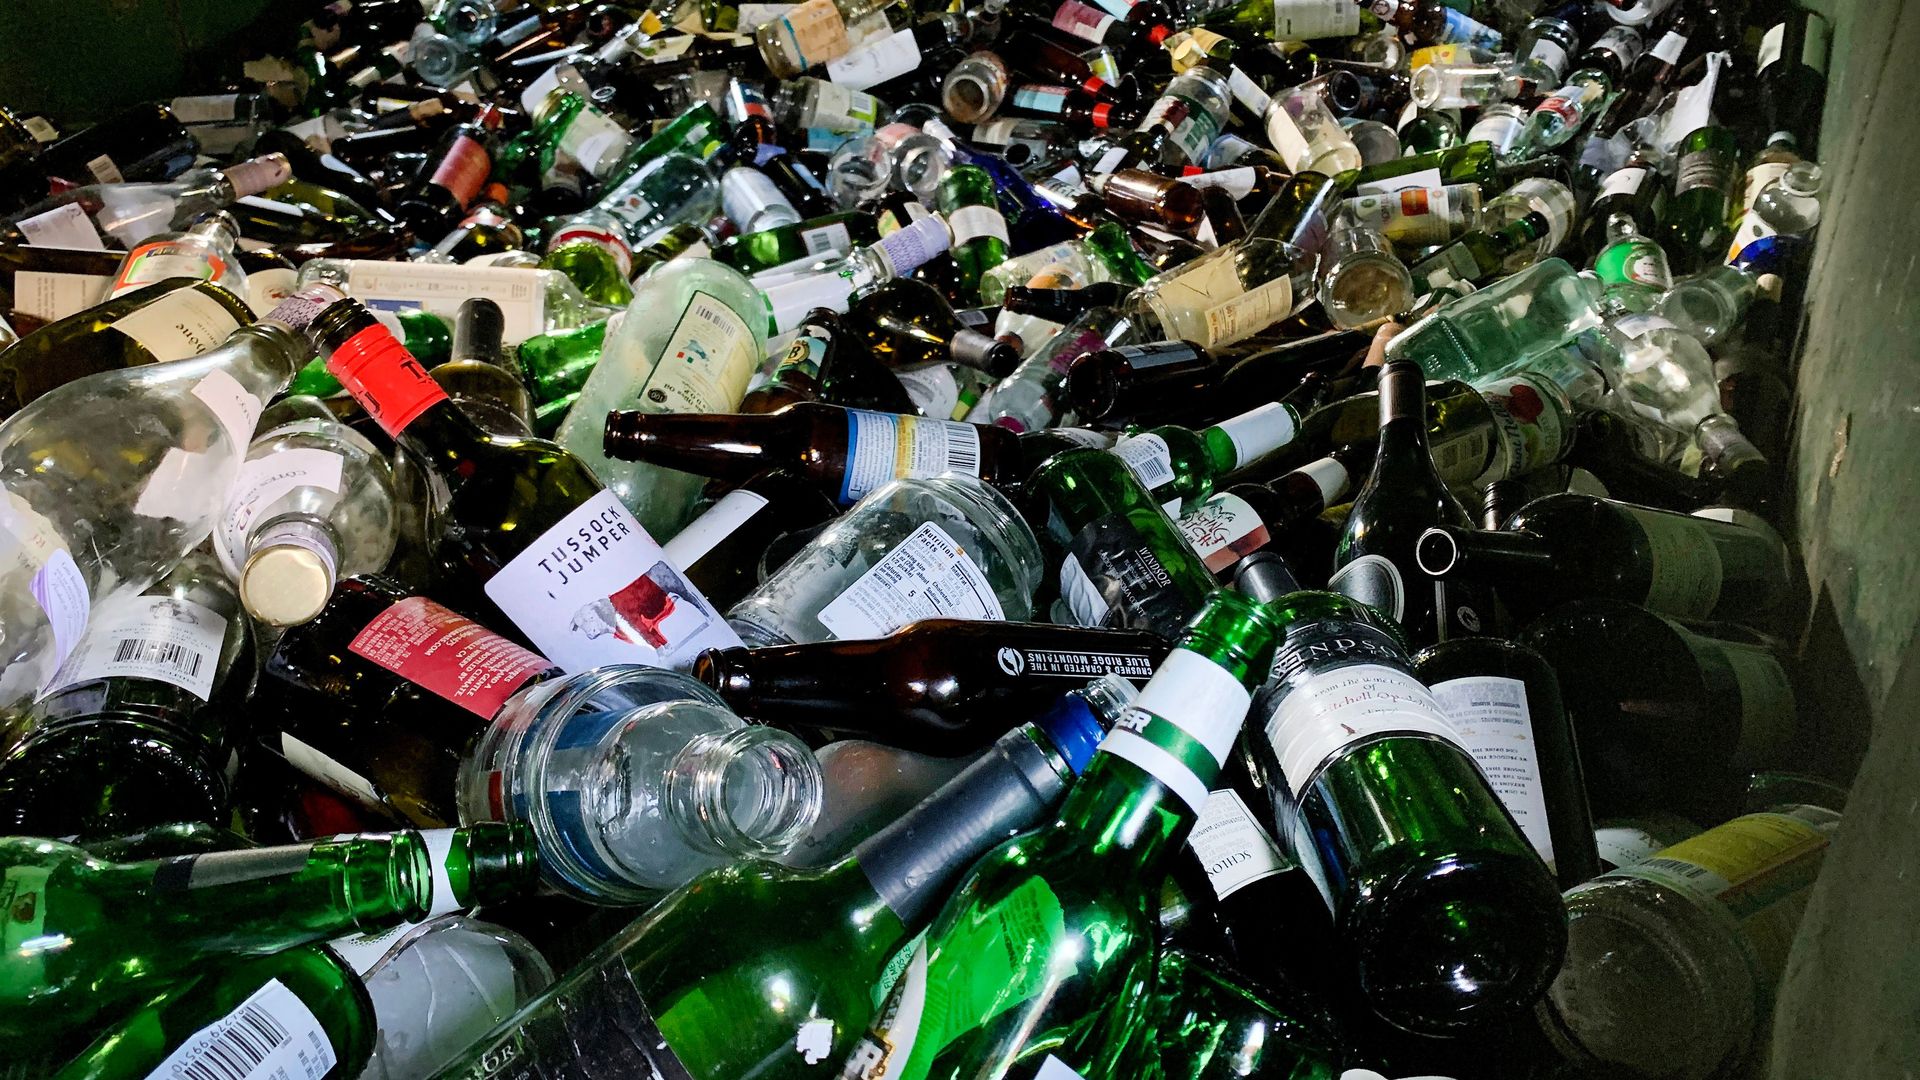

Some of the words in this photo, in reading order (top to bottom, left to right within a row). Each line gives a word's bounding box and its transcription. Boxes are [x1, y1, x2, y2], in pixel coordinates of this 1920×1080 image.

[537, 505, 620, 573] TUSSOCK
[917, 533, 938, 552] Facts
[922, 527, 955, 559] Nutrition
[555, 521, 629, 585] JUMPER
[900, 548, 917, 563] Serving
[917, 562, 925, 570] size
[883, 562, 902, 580] Calories
[950, 565, 961, 578] Total
[1138, 546, 1171, 586] WINDSOR
[916, 571, 928, 583] about
[455, 649, 467, 658] CA
[1027, 652, 1087, 663] MOUNTAINS
[1029, 662, 1046, 671] THE
[1050, 663, 1060, 671] IN
[1091, 656, 1120, 666] RIDGE
[1125, 657, 1149, 667] BLUE
[1063, 664, 1101, 672] CRAFTED
[1114, 666, 1151, 674] CRUSHED
[457, 670, 467, 681] BY
[453, 667, 482, 698] CLIMATE.
[466, 672, 490, 697] GENTLE
